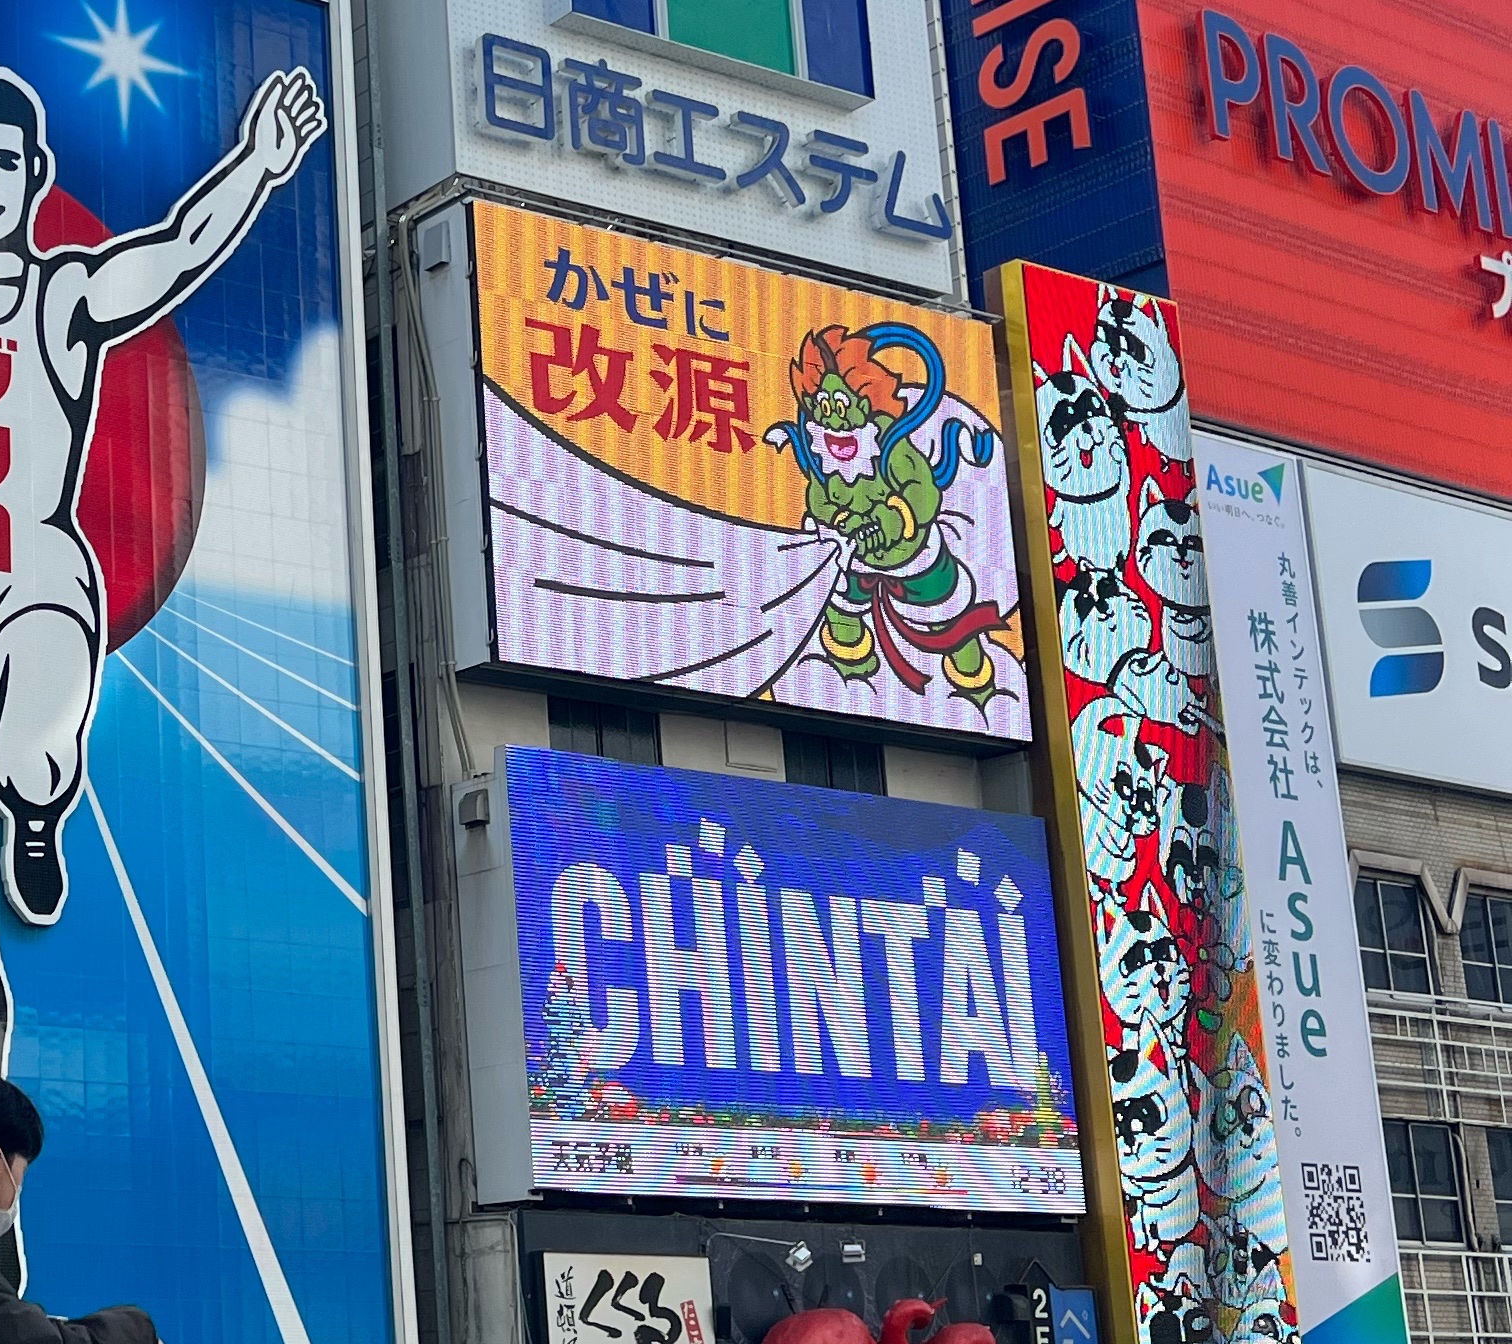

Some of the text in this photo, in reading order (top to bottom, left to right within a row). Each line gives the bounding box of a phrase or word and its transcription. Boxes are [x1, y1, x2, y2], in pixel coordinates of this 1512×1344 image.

[482, 32, 953, 241] 日商エステム
[524, 317, 763, 454] 改源
[545, 246, 730, 343] かぜに
[1206, 463, 1264, 503] Asue
[1277, 552, 1323, 788] 丸善インテックは、
[1247, 608, 1328, 1058] 株式会社 Asue
[1260, 909, 1302, 1138] に変わりました。
